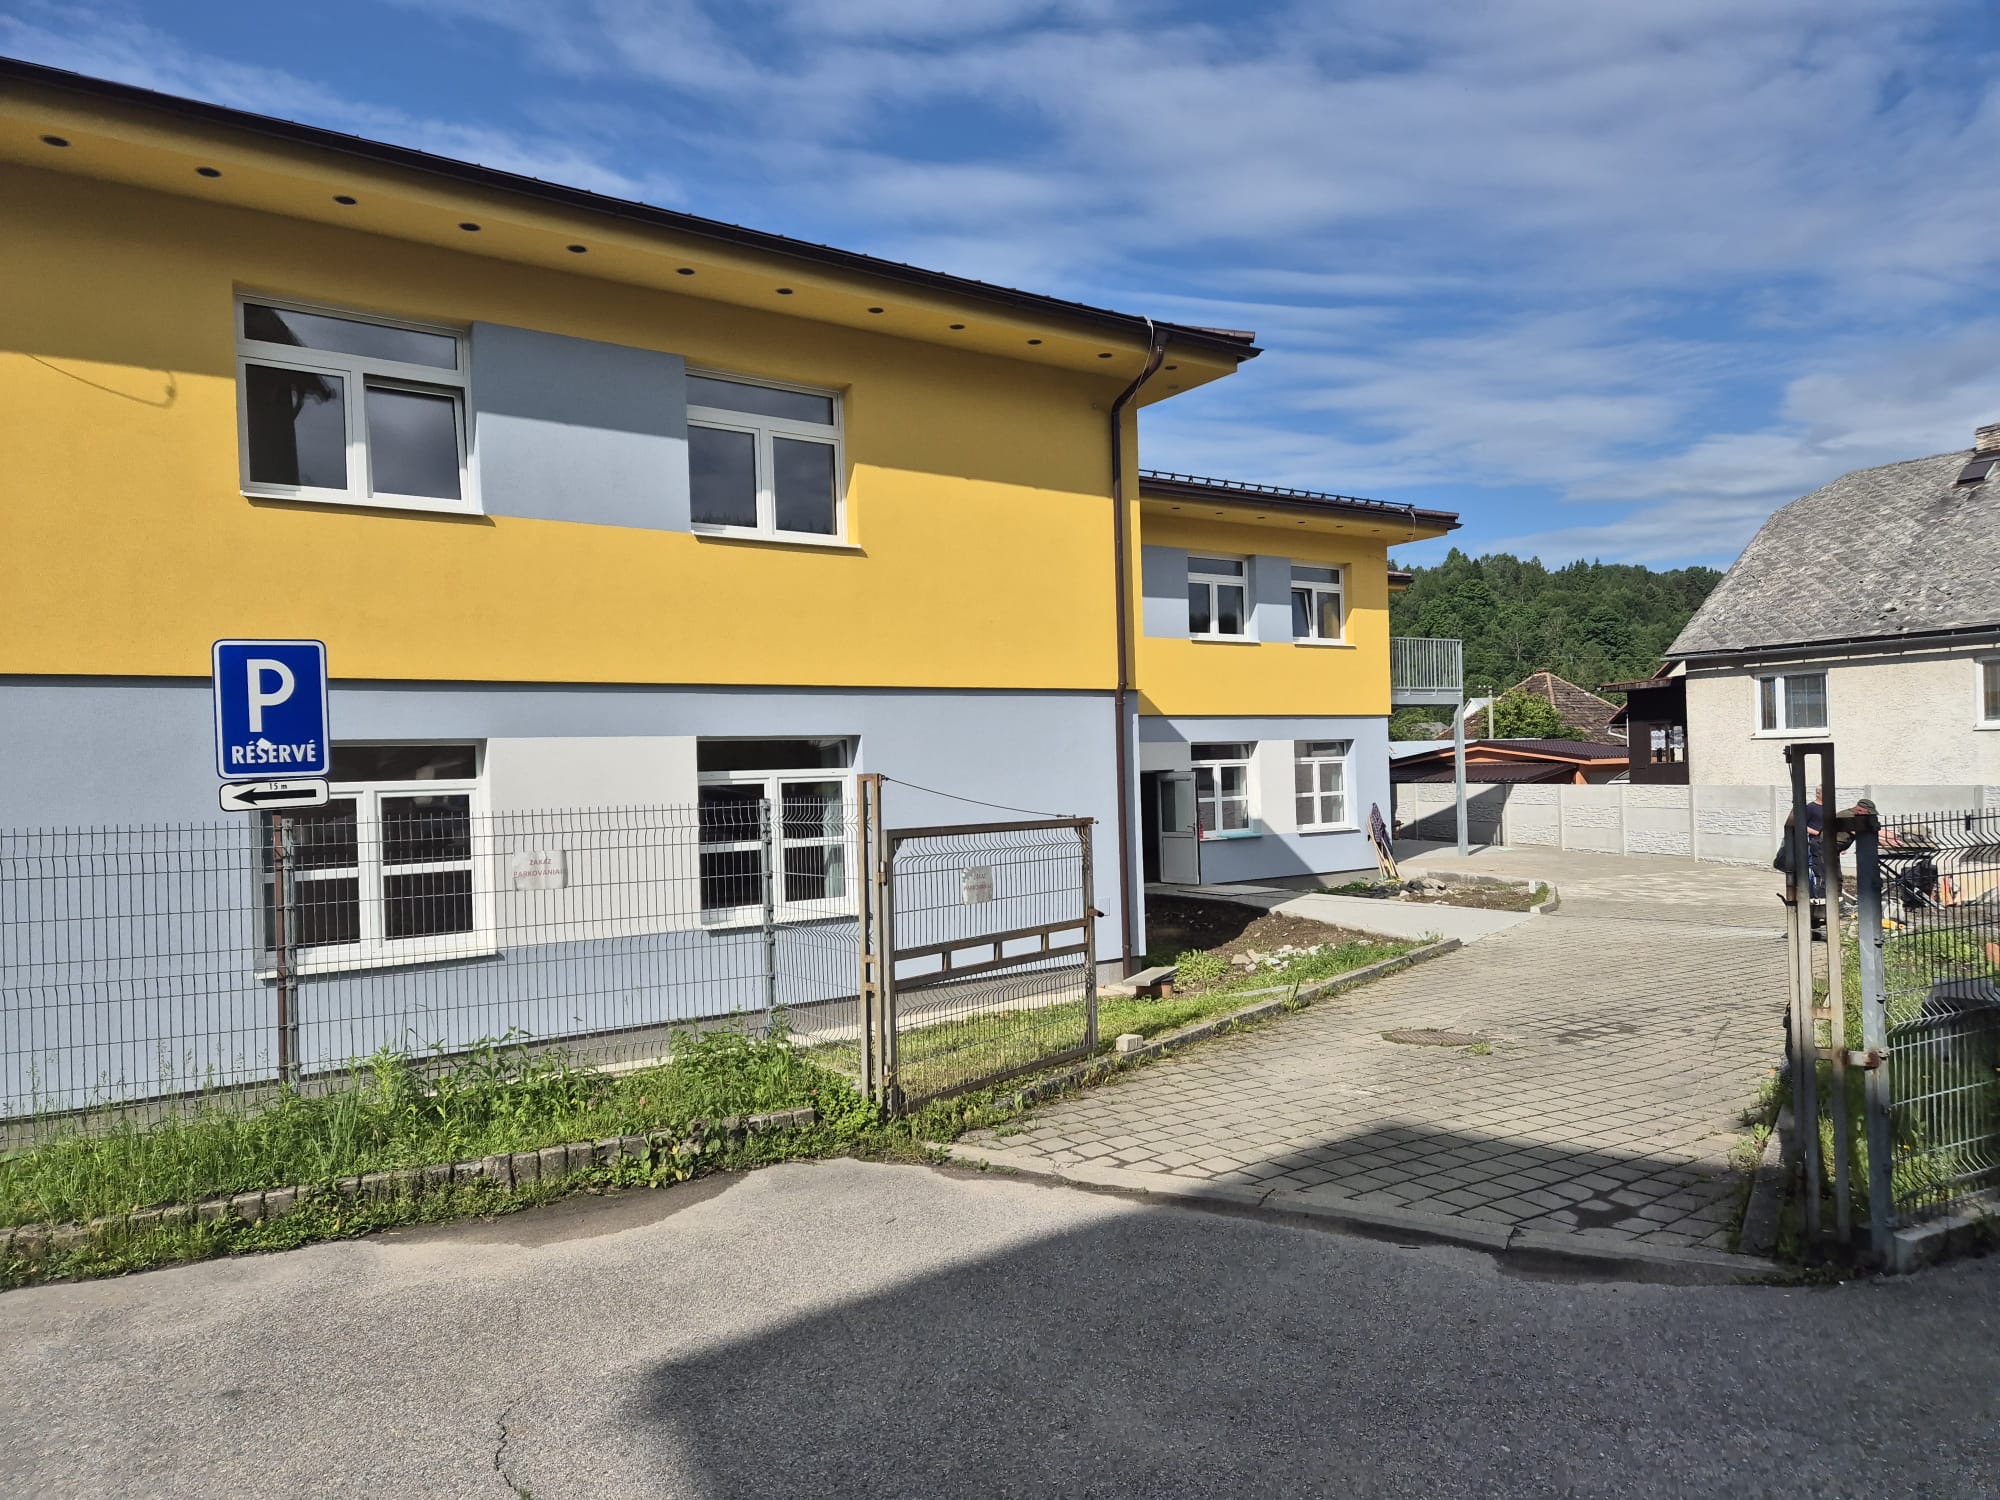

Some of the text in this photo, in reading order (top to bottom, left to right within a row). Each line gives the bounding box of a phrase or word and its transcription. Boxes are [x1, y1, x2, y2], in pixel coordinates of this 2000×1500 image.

[246, 658, 295, 733] P
[231, 739, 316, 765] RÉSERVÉ
[269, 782, 279, 791] 15
